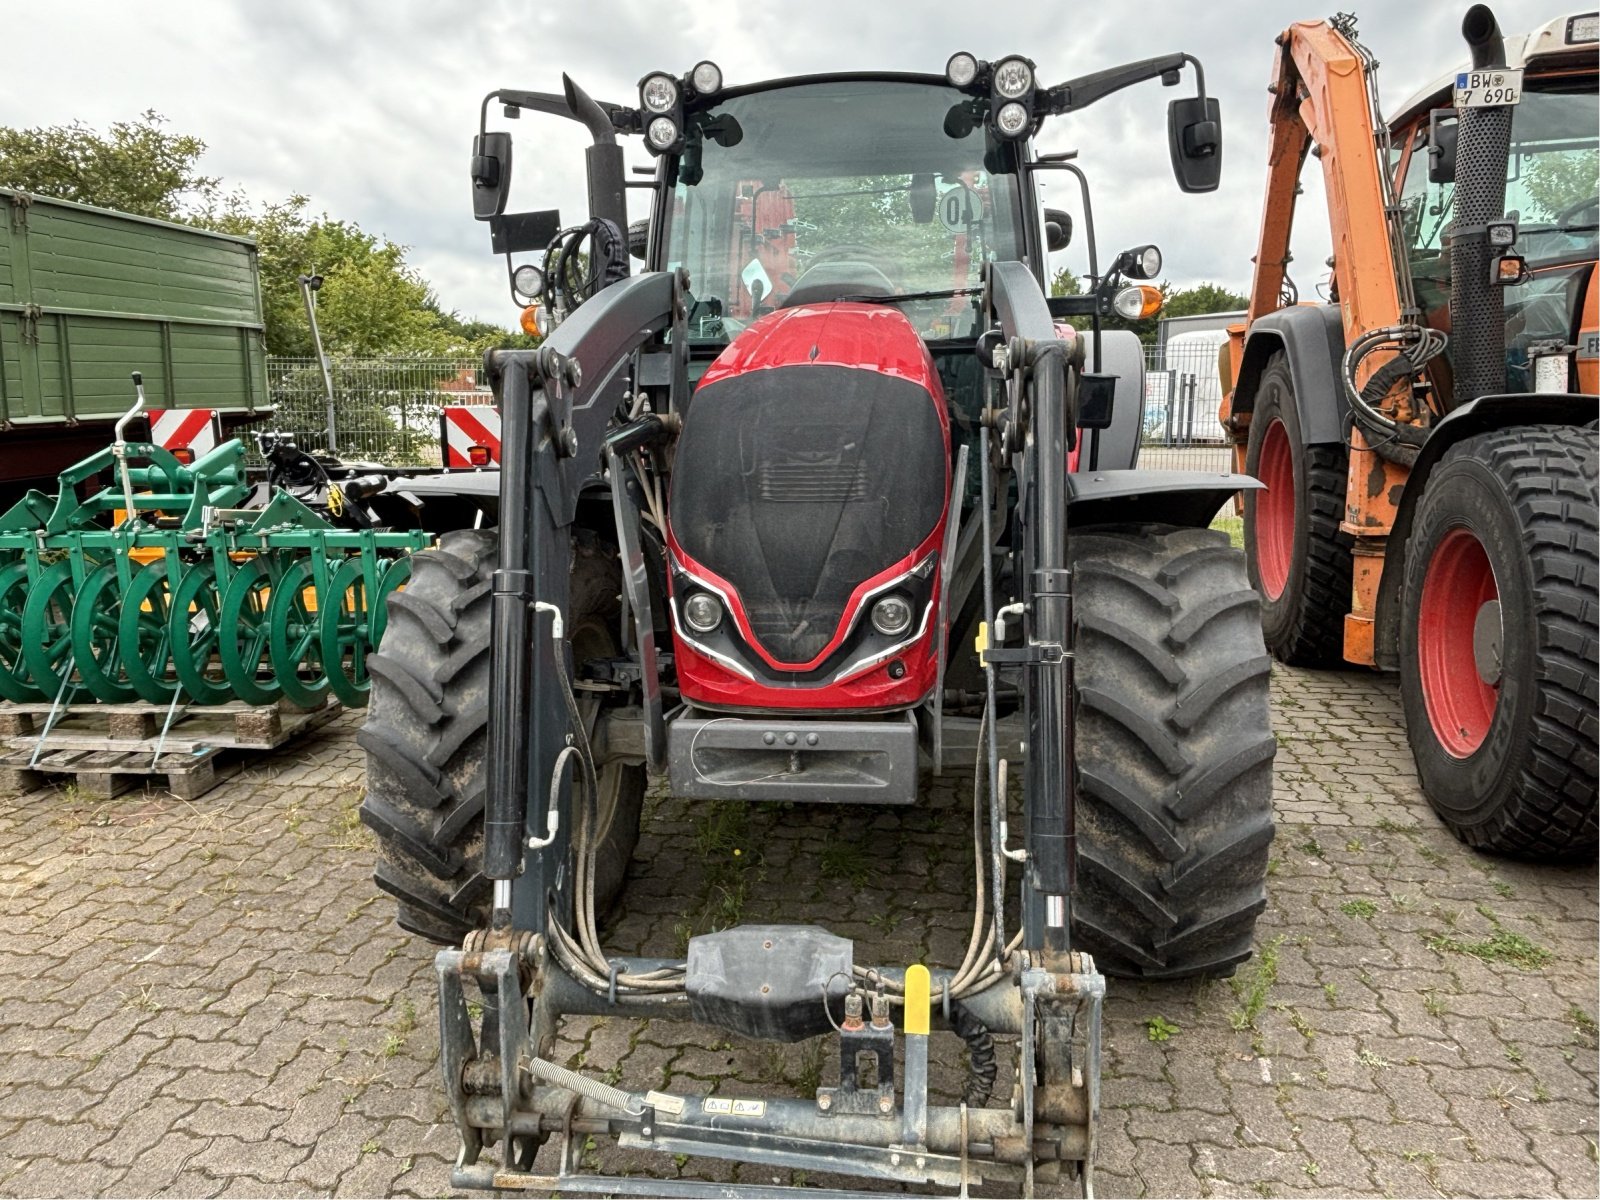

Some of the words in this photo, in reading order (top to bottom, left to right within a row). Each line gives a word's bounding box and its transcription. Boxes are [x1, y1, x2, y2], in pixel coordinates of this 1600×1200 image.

[1471, 74, 1492, 89] BW
[1463, 90, 1473, 105] 7
[1484, 88, 1514, 104] 690
